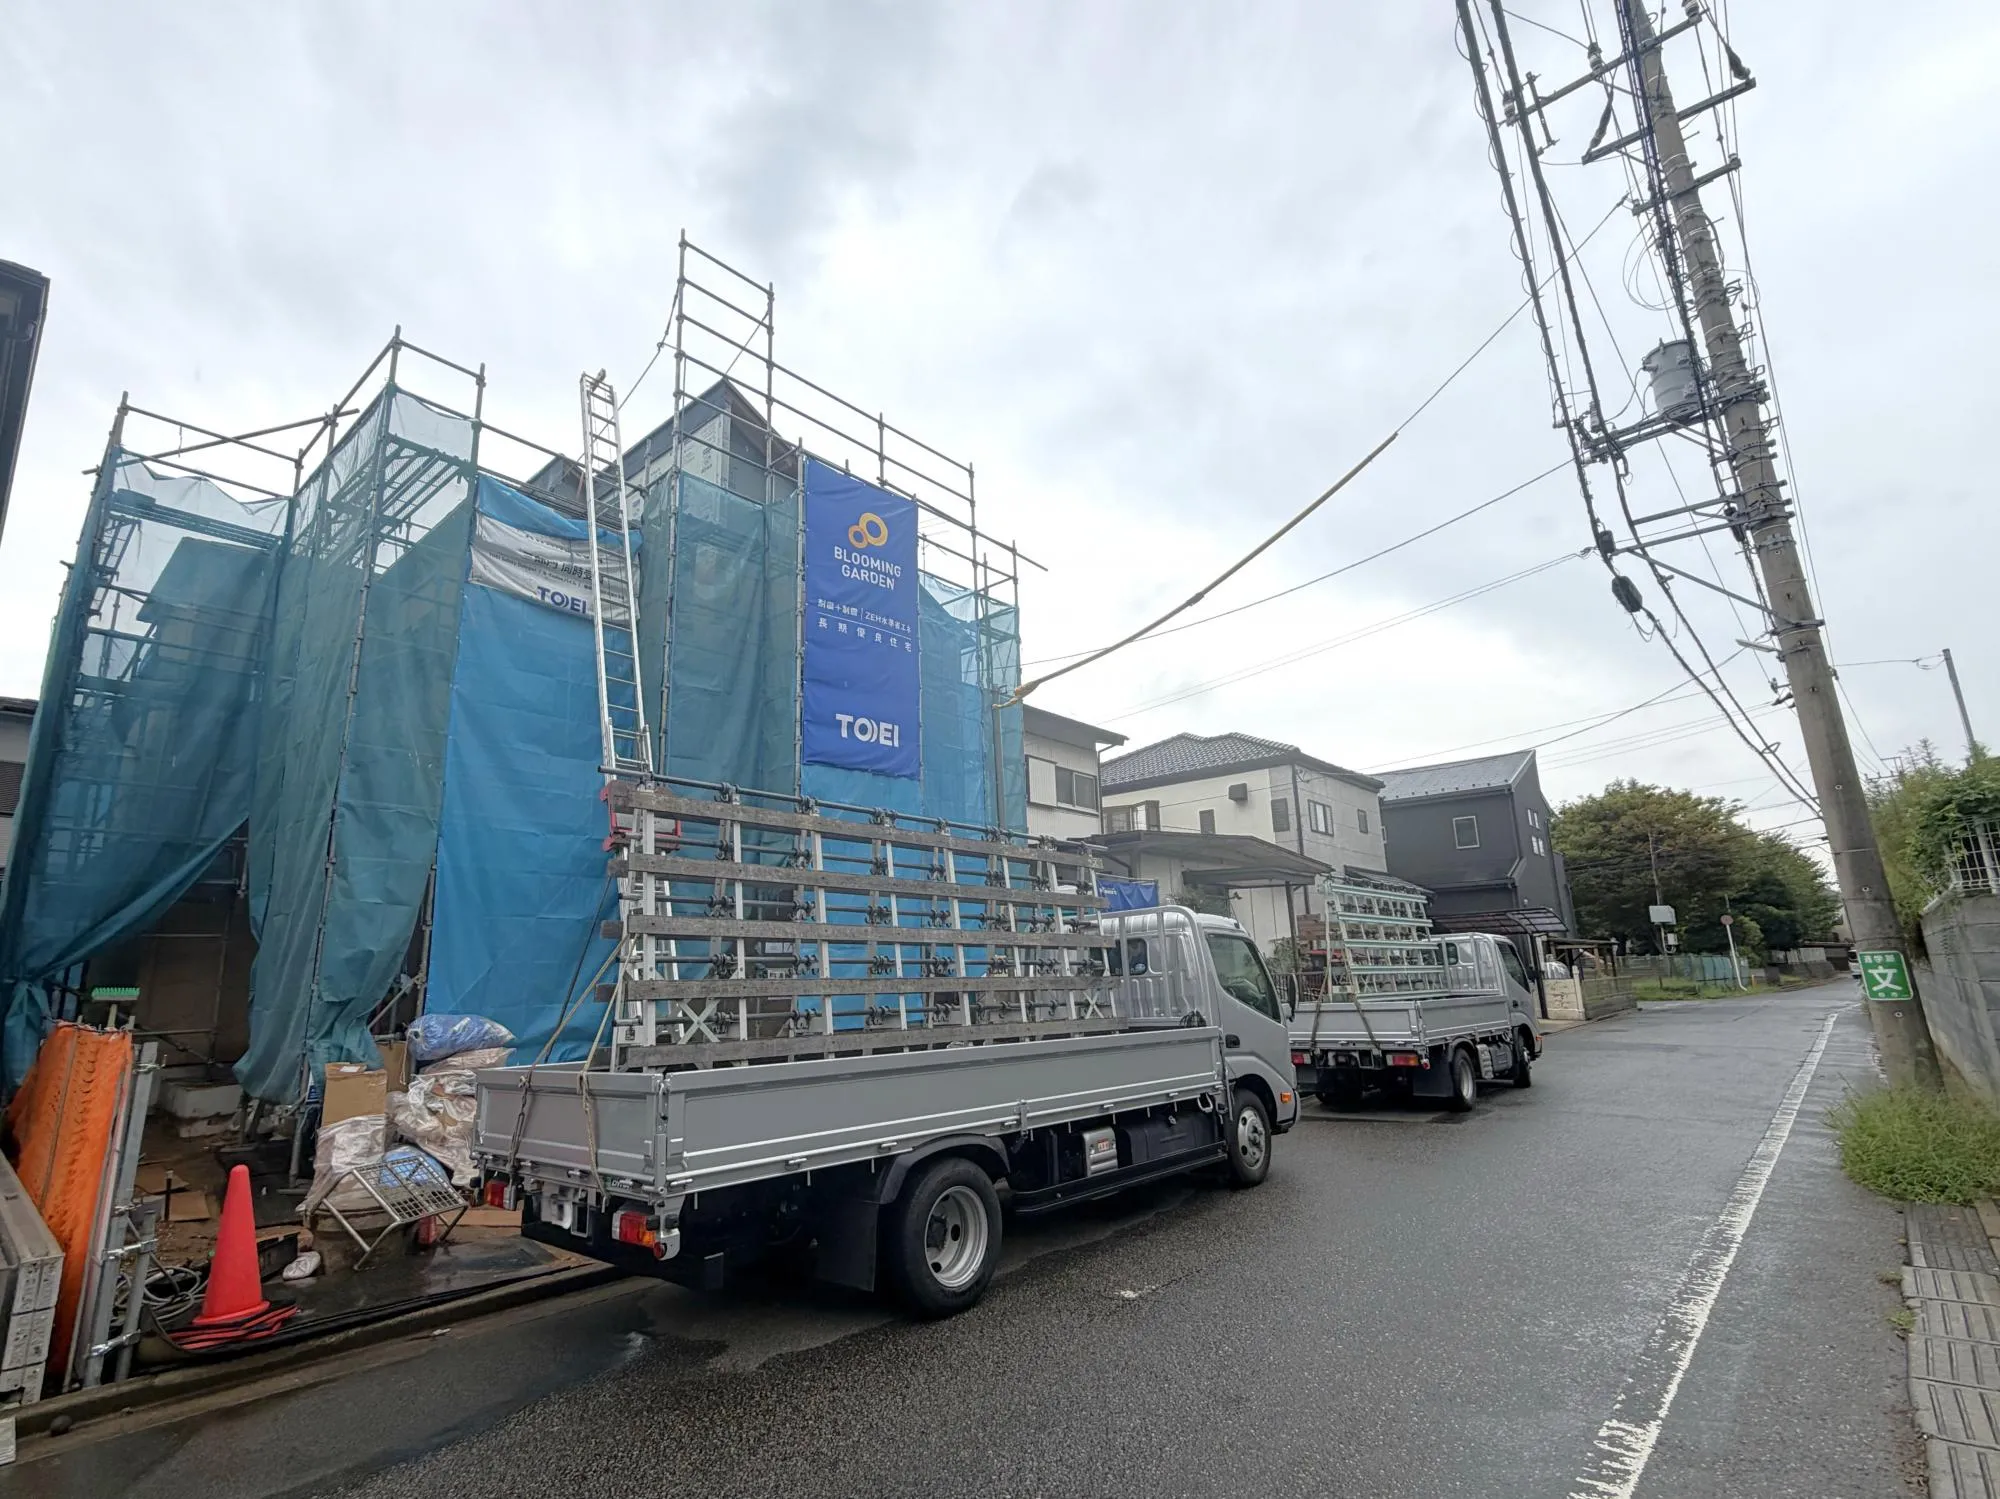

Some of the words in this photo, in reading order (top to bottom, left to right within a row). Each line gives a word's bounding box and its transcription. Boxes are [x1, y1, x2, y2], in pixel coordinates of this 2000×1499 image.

[834, 545, 902, 577] BLOOMING
[841, 564, 895, 590] GARDEN
[536, 585, 587, 614] TOEI
[818, 617, 912, 653] 長期優良住宅
[835, 713, 899, 748] TOEI
[1867, 965, 1903, 991] 文
